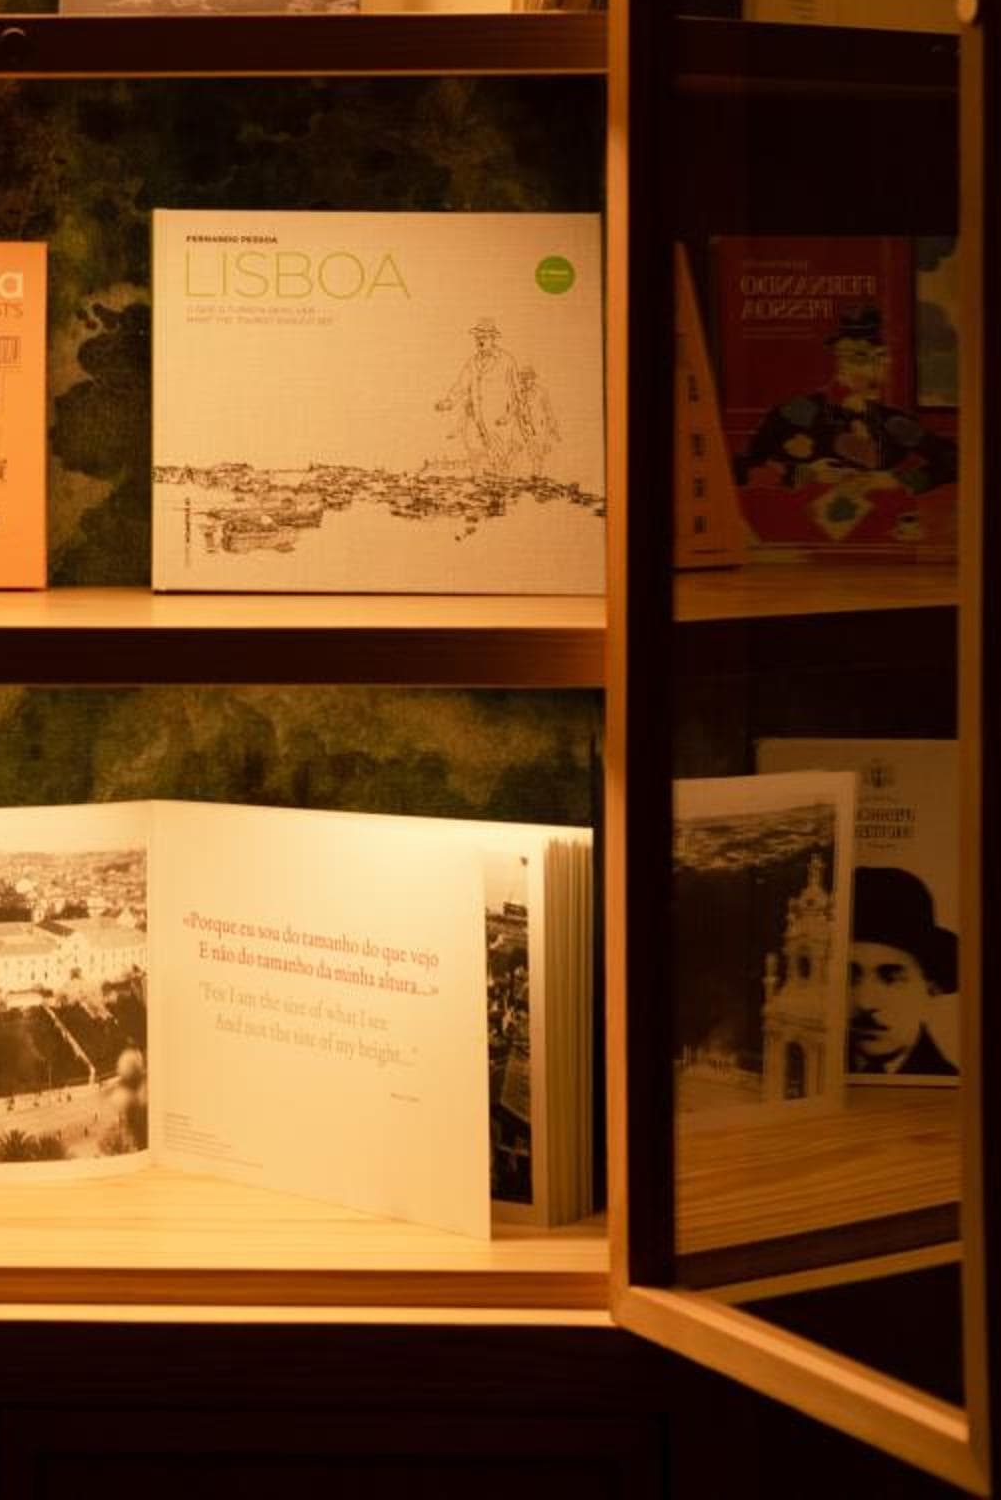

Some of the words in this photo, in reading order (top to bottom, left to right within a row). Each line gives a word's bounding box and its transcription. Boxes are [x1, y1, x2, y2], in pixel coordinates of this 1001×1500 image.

[185, 250, 412, 300] LISBOA
[199, 940, 209, 959] E
[316, 958, 333, 981] da
[382, 947, 408, 969] que
